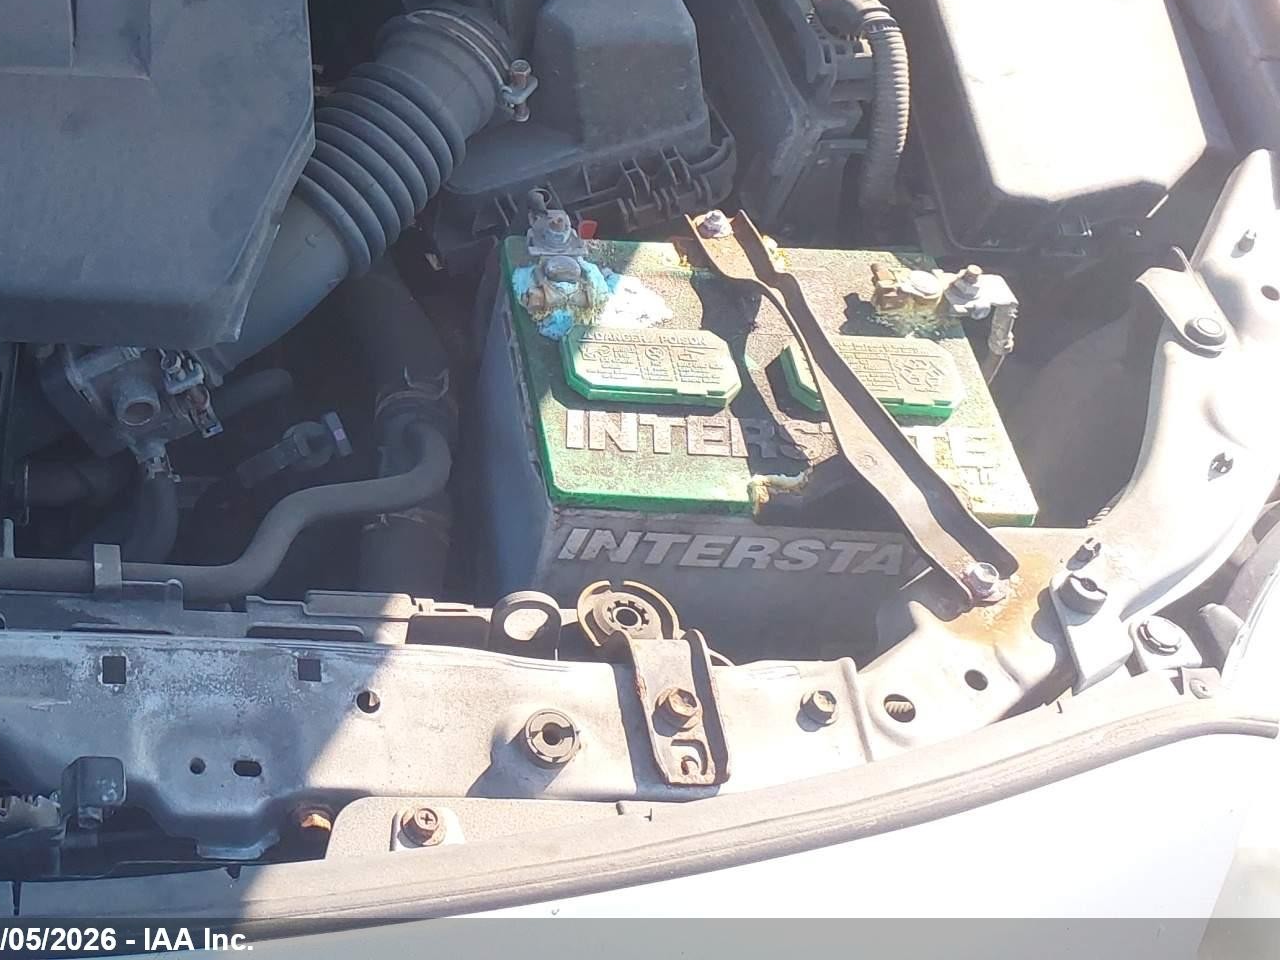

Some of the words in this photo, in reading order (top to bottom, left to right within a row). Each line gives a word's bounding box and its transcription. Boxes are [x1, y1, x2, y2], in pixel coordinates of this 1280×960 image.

[593, 331, 646, 344] DANGER
[659, 334, 705, 346] POISON
[565, 408, 1001, 469] INTERSTE
[557, 527, 928, 578] INTERSTA
